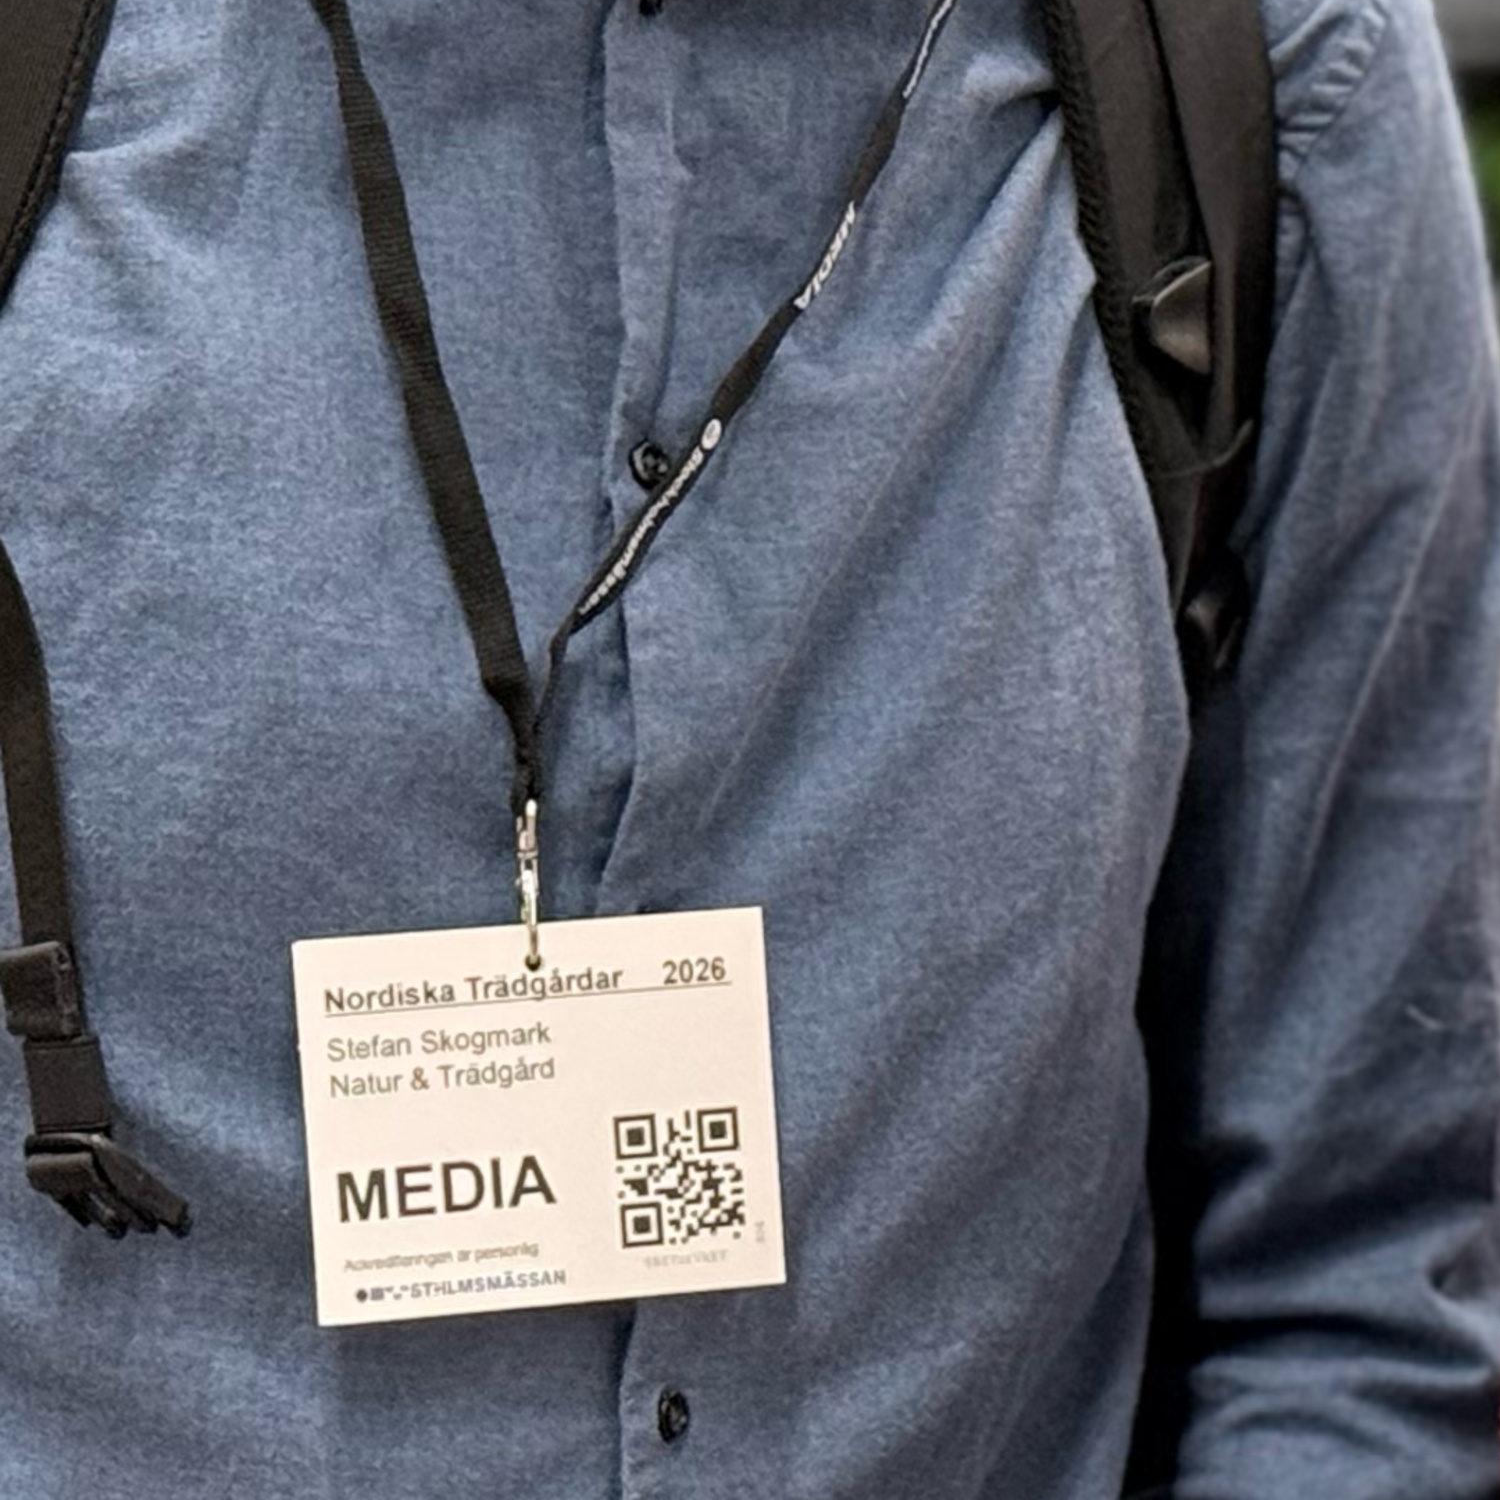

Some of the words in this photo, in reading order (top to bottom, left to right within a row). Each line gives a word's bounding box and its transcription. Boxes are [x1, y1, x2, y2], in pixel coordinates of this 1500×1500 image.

[324, 980, 456, 1013] Nordiska
[464, 968, 624, 1001] Trädgårdar
[662, 957, 727, 985] 2026
[327, 1034, 413, 1062] Stefan
[421, 1021, 552, 1055] Skogmark
[330, 1073, 403, 1098] Natur
[410, 1066, 430, 1091] &
[437, 1056, 556, 1089] Trädgård
[337, 1155, 558, 1223] MEDIA
[410, 1269, 567, 1299] STHLMSMÄSSAN
